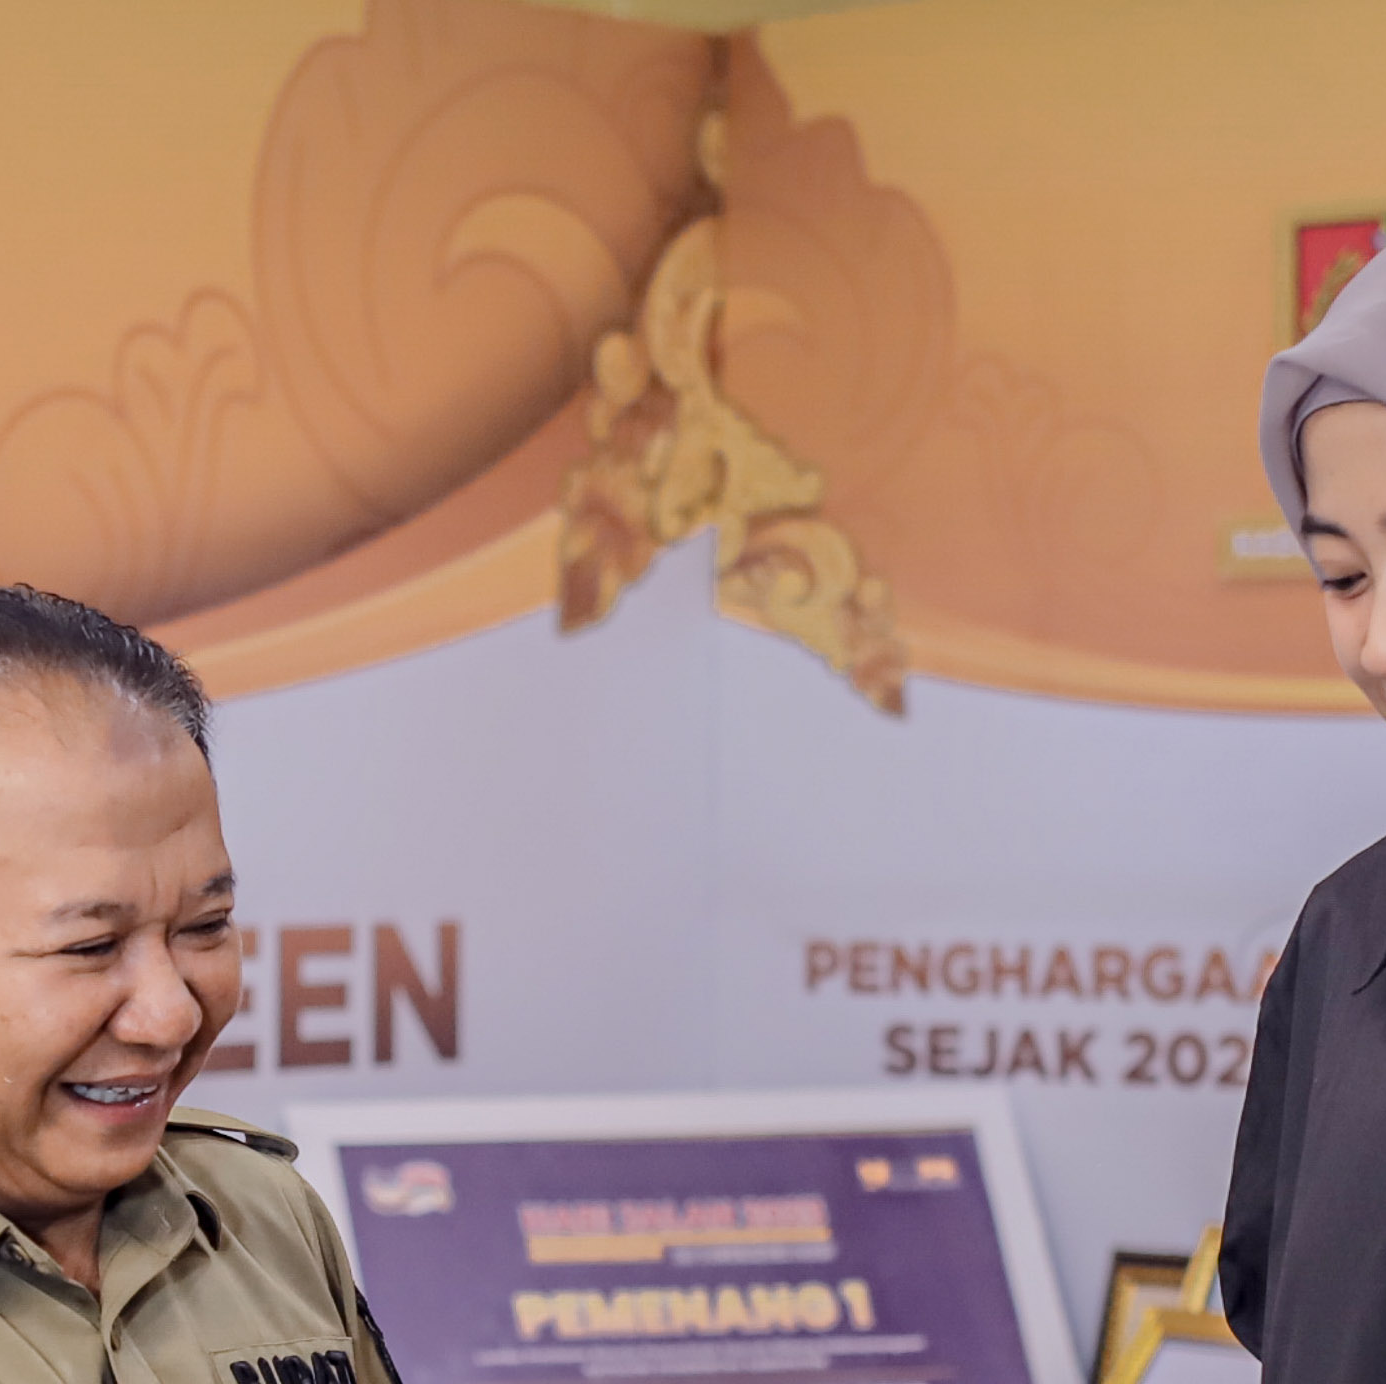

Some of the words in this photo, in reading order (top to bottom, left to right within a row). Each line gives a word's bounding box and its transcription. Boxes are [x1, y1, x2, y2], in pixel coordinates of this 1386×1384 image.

[803, 939, 1278, 1003] PENGHARGA
[883, 1022, 1097, 1085] SEJAK
[1123, 1031, 1250, 1088] 202
